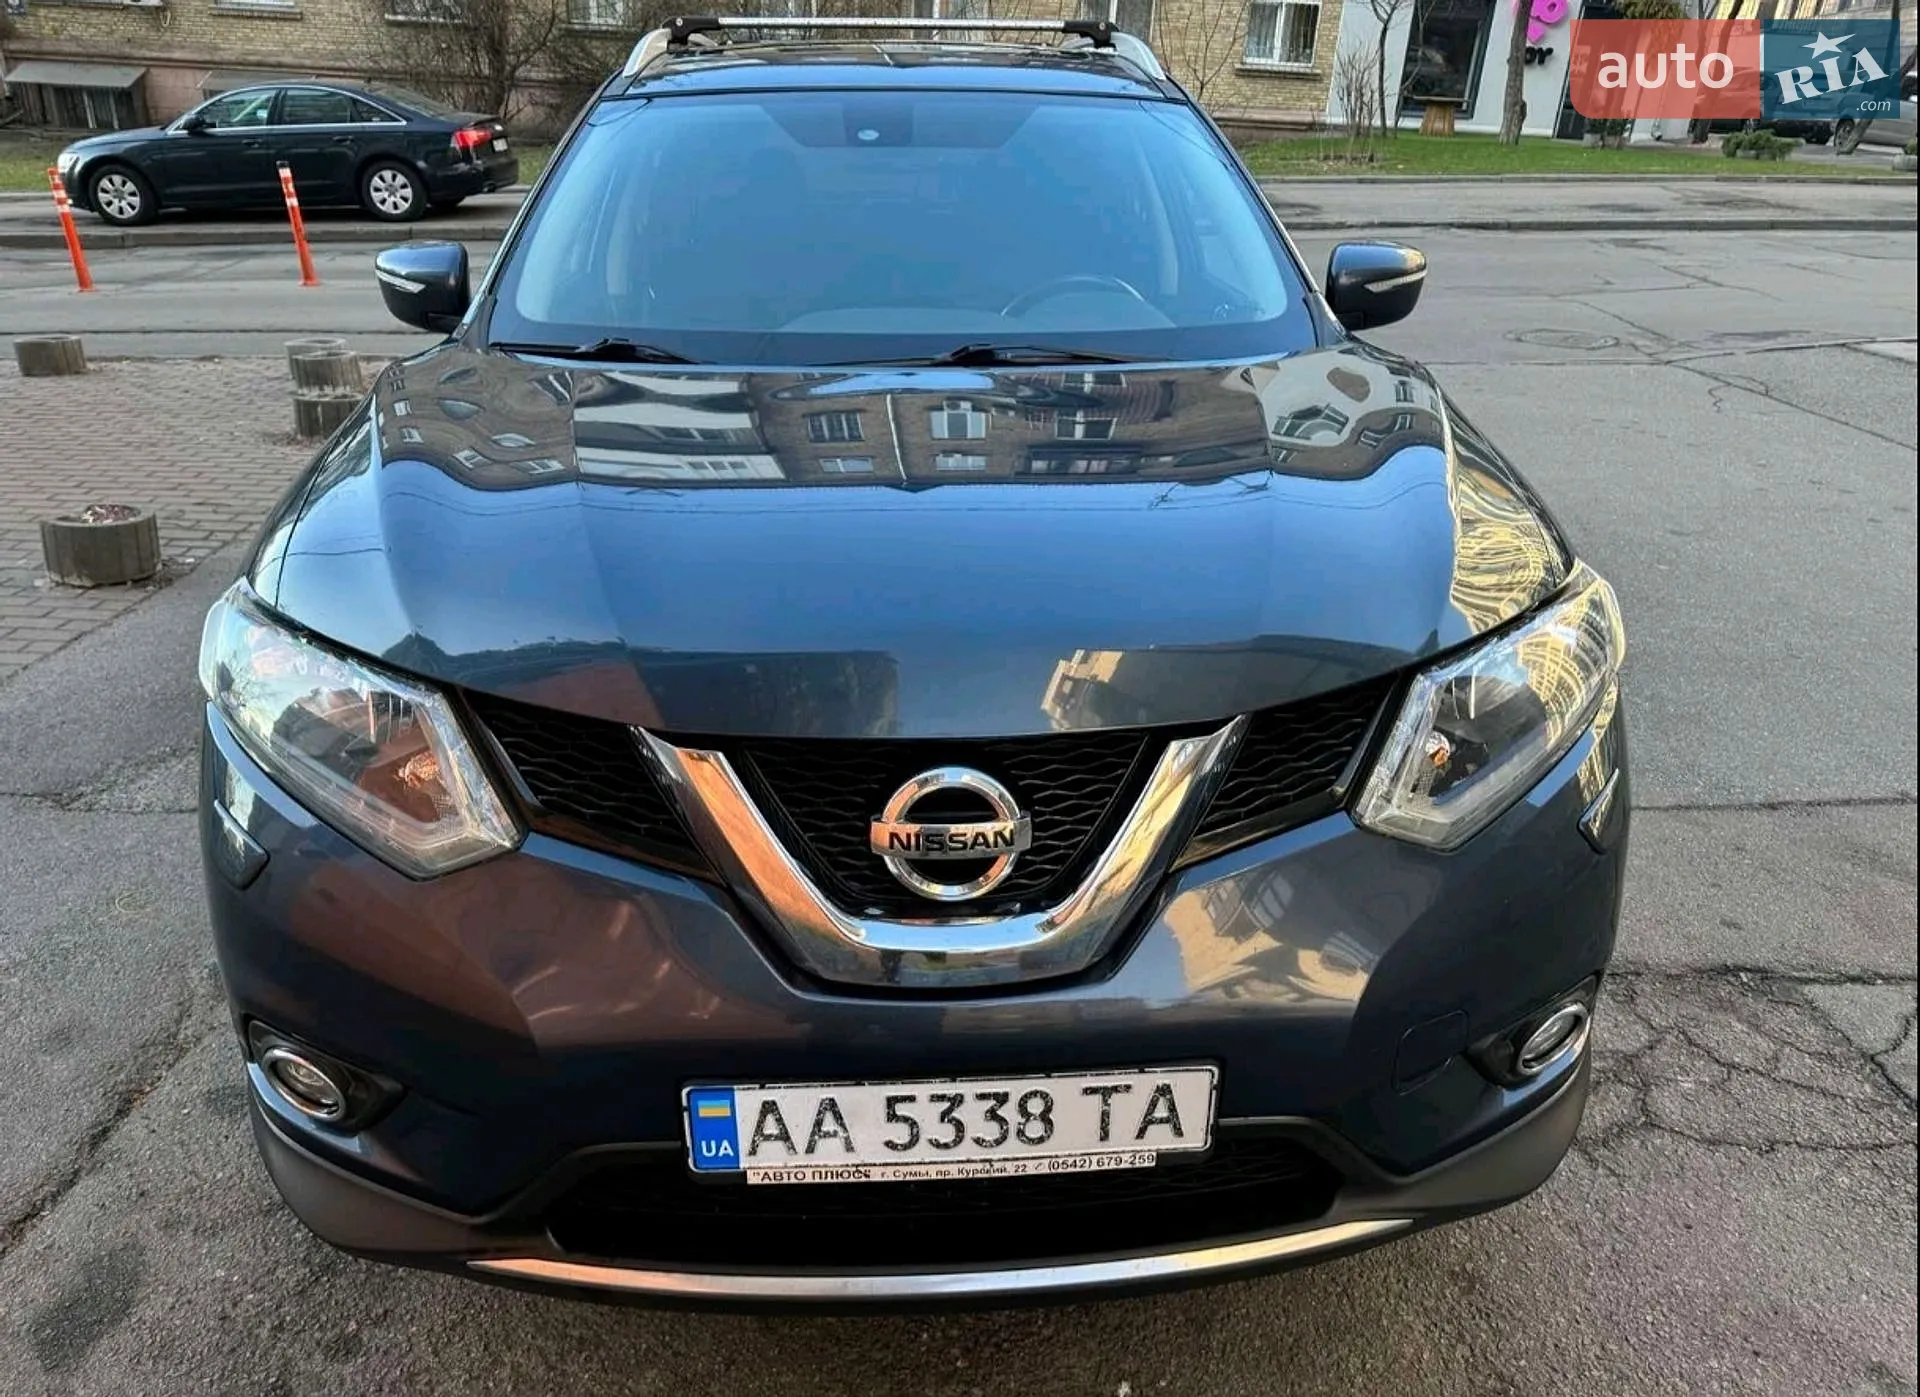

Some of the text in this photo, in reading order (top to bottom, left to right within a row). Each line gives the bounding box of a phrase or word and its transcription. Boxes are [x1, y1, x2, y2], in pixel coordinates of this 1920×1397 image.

[889, 829, 1016, 851] NISSAN
[748, 1083, 1184, 1156] AA 5338 TA
[701, 1139, 734, 1158] UA
[1047, 1157, 1092, 1172] (0542)
[1096, 1153, 1155, 1168] 679-259
